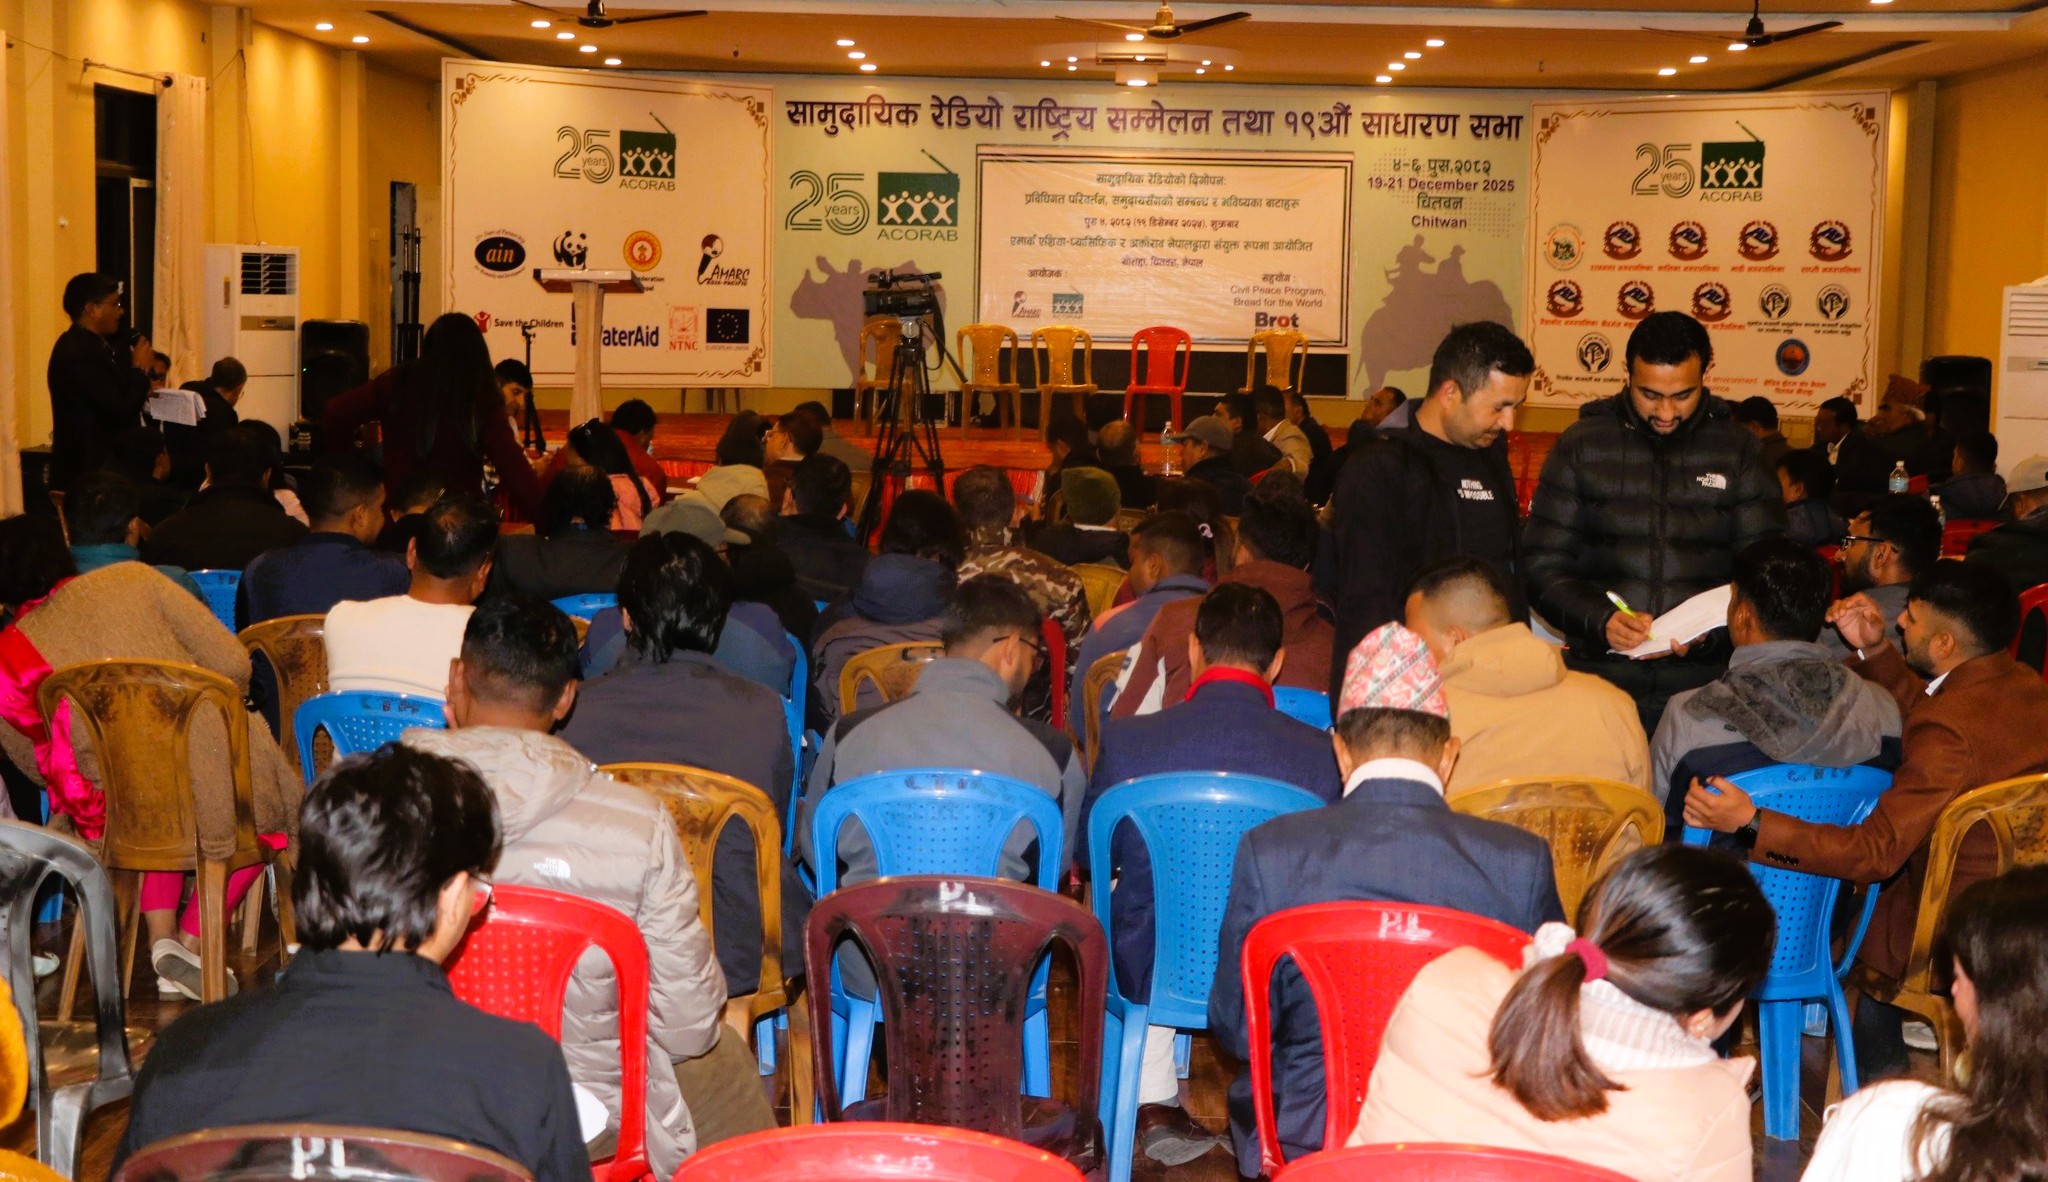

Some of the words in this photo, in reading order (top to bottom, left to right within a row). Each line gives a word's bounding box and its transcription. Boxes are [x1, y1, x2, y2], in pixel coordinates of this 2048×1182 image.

[786, 94, 921, 136] सामुदायिक
[930, 95, 1003, 129] रेडियो
[1013, 97, 1097, 140] राष्ट्रिय
[1107, 99, 1213, 133] सम्मेलन
[1222, 110, 1275, 136] तथा
[1361, 112, 1460, 138] साधारण
[1469, 113, 1523, 139] सभा
[554, 126, 614, 184] 25
[582, 157, 607, 168] years
[1632, 143, 1695, 198] 25
[1660, 172, 1687, 183] years
[619, 179, 676, 191] ACORAB
[1368, 176, 1403, 189] 19-21
[1408, 178, 1478, 191] December
[1482, 180, 1515, 192] 2025
[785, 170, 870, 236] 25
[1417, 192, 1464, 209] चितवन
[1700, 191, 1763, 202] ACORAB
[824, 205, 860, 218] years
[1411, 215, 1467, 229] Chitwan
[877, 229, 958, 242] ACORAB
[486, 243, 514, 263] ain
[711, 264, 750, 281] AMARC
[1230, 285, 1250, 295] Civil
[1252, 285, 1282, 295] Peace
[1233, 298, 1261, 307] Bread
[1263, 298, 1276, 307] for
[1279, 298, 1293, 307] the
[1296, 299, 1323, 308] World
[494, 318, 513, 328] Save
[529, 318, 564, 329] Children
[1255, 312, 1299, 328] Brot
[601, 324, 659, 347] aterAid
[670, 341, 698, 351] NTNC
